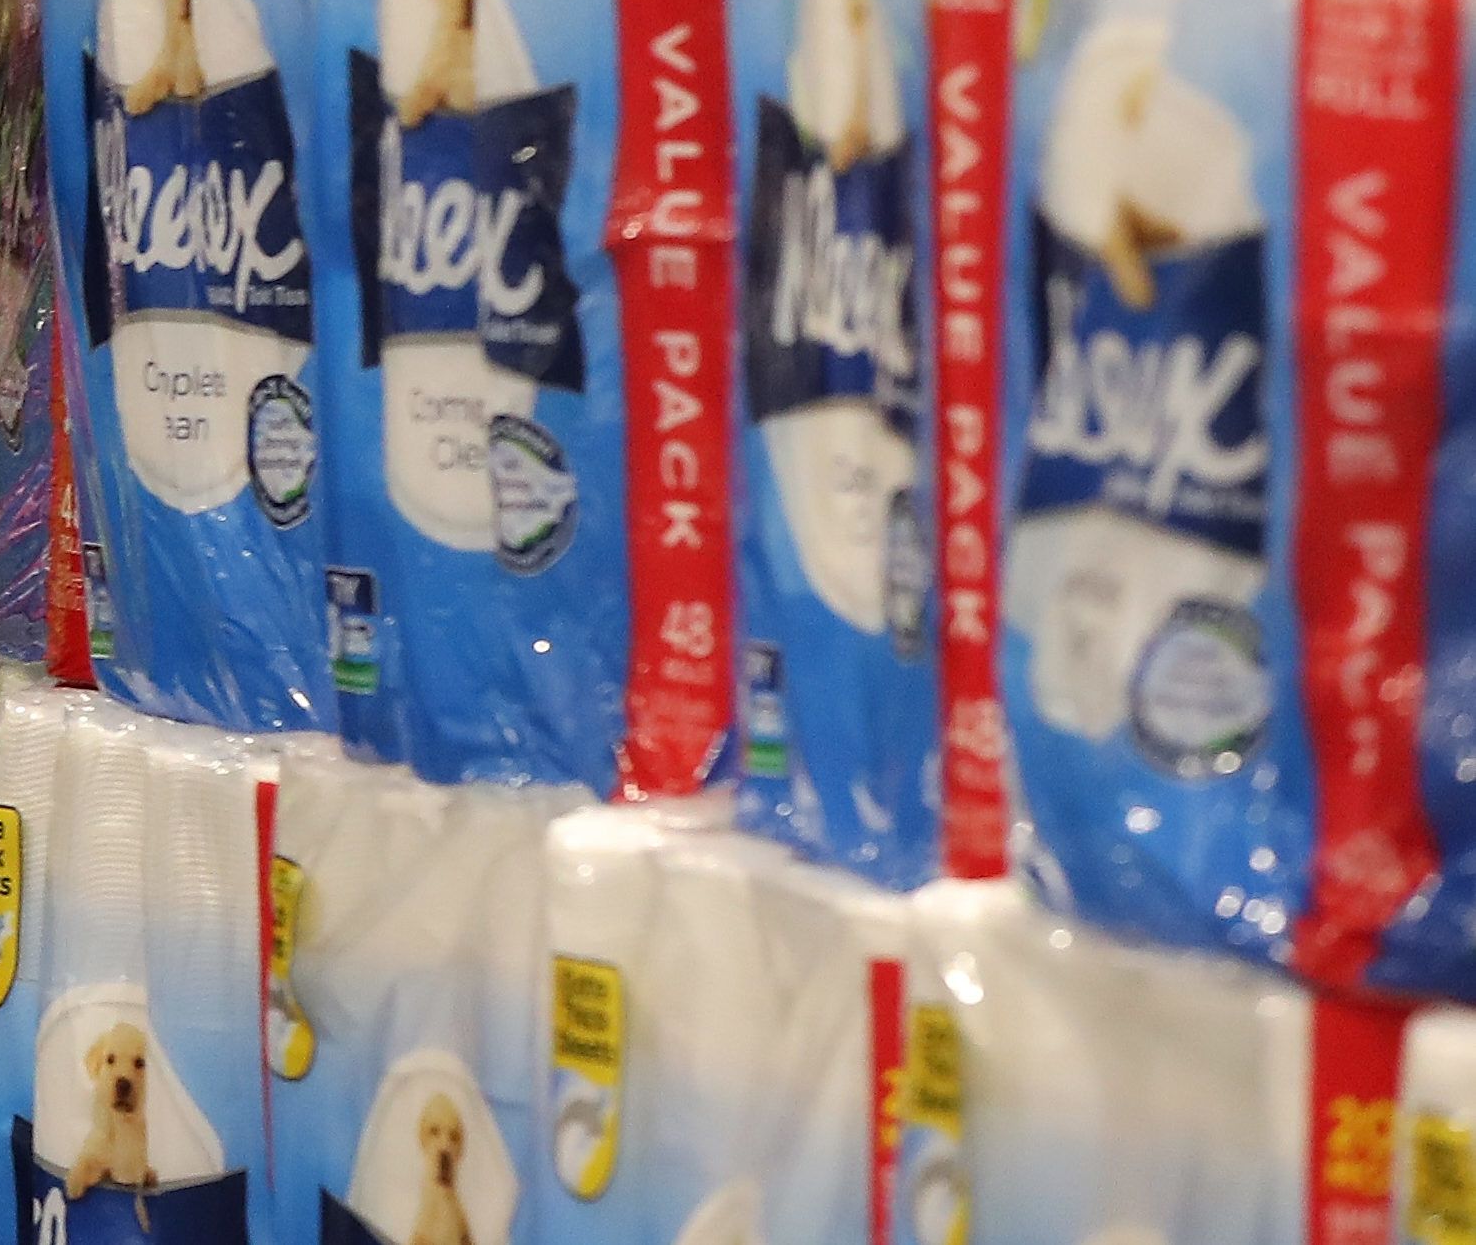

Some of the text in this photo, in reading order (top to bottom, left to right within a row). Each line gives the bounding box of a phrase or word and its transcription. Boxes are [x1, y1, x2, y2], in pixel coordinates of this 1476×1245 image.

[649, 23, 705, 552] VALUE PACK
[660, 597, 715, 661] 48
